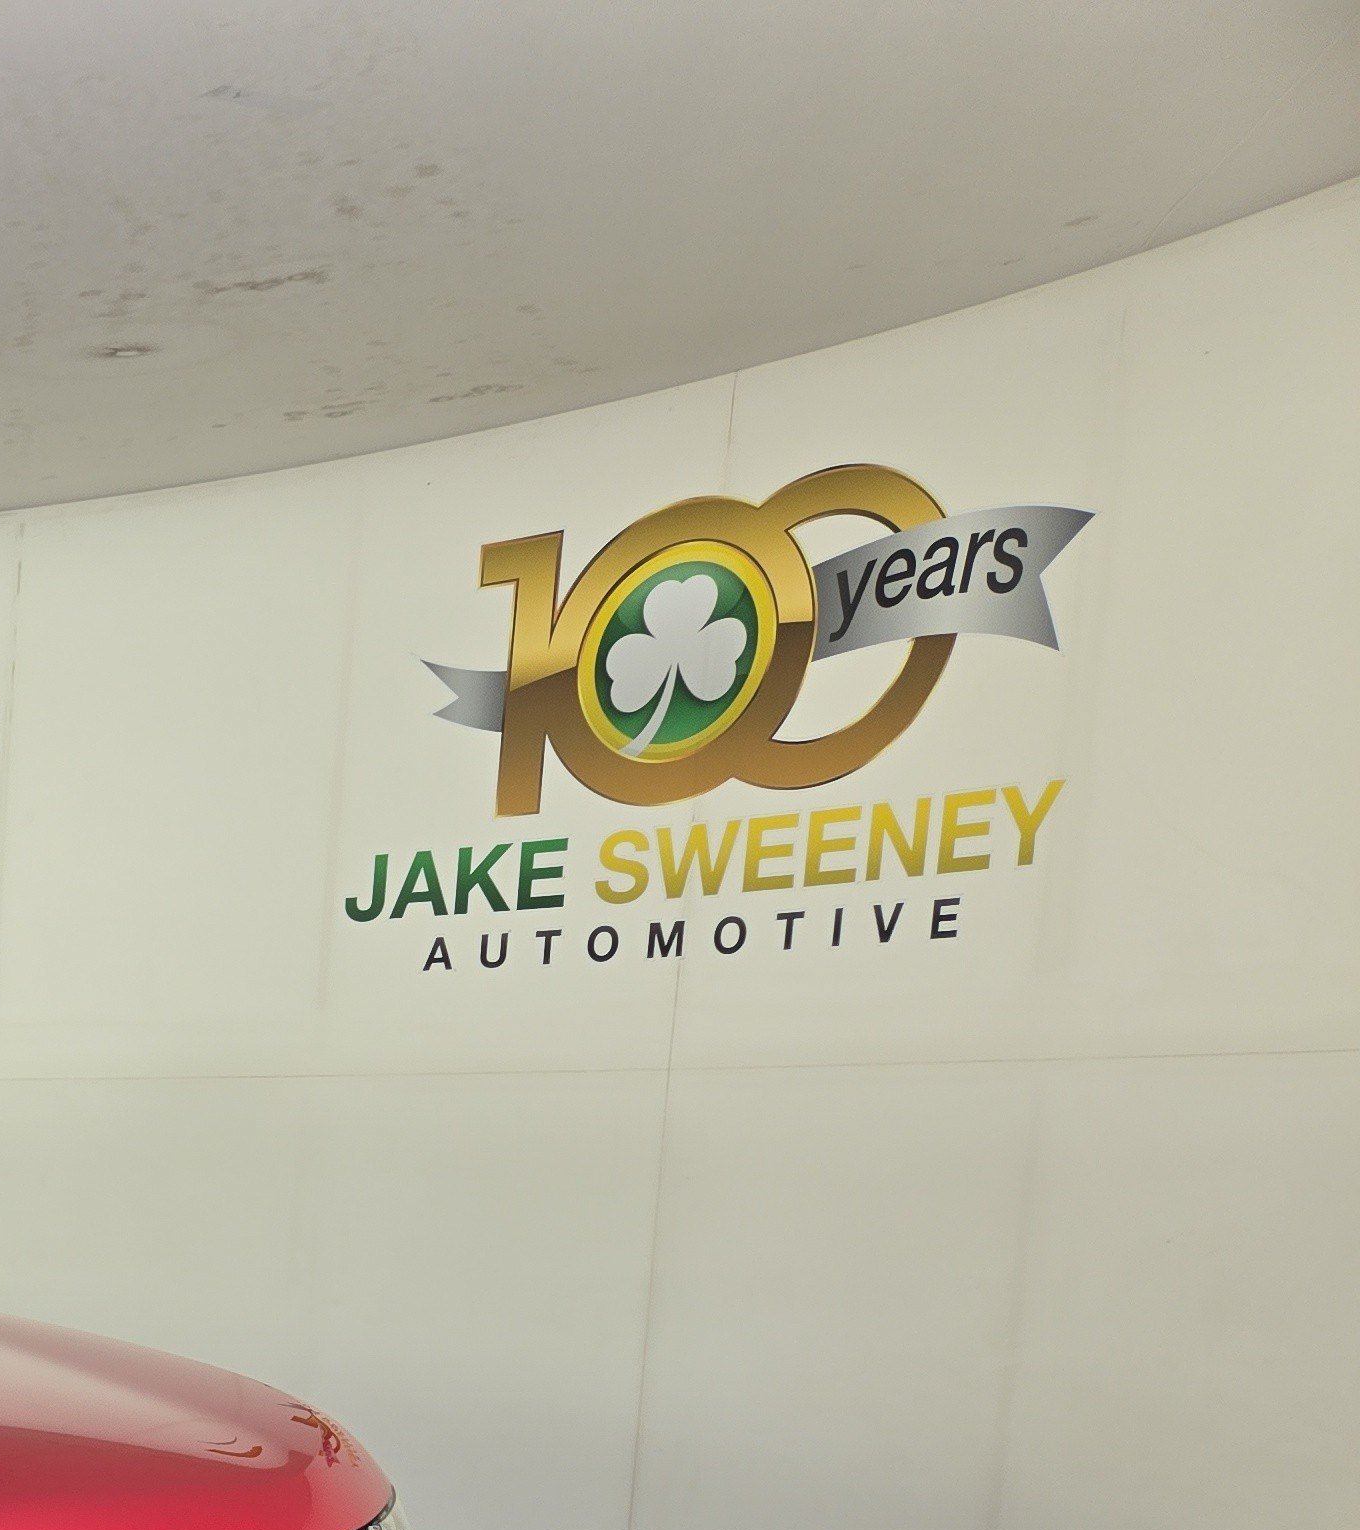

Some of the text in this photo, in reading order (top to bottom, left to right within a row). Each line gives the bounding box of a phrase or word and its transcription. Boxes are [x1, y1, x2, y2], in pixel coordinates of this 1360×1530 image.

[479, 463, 957, 817] 100
[828, 526, 1028, 642] years
[344, 779, 1066, 922] JAKE SWEENEY
[422, 897, 962, 972] AUTOMOTIVE
